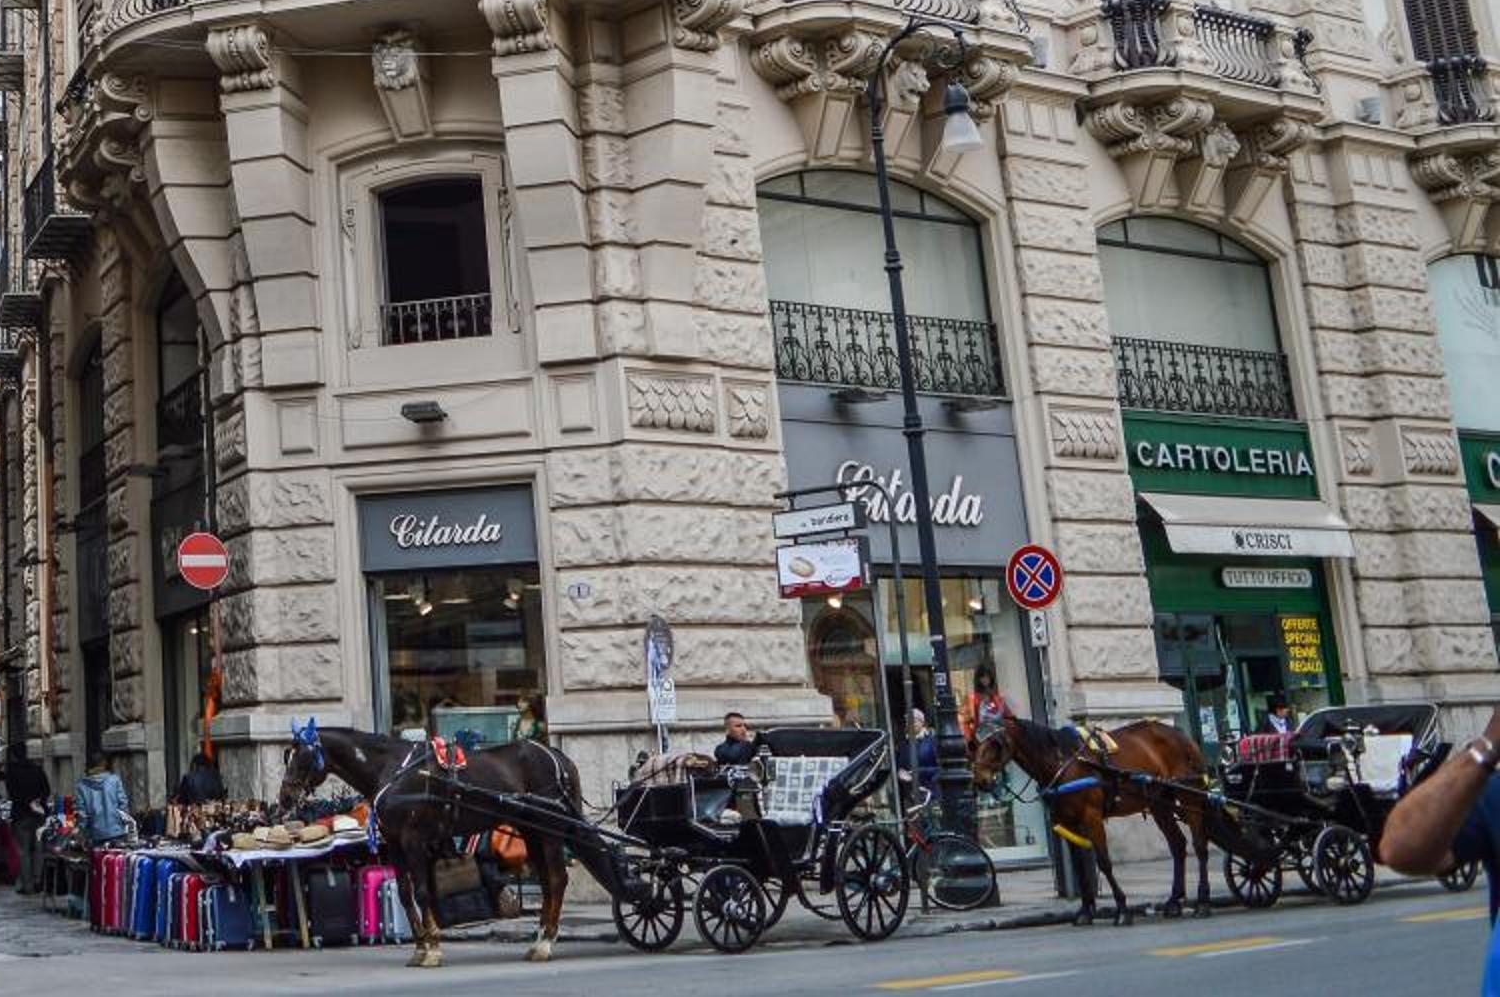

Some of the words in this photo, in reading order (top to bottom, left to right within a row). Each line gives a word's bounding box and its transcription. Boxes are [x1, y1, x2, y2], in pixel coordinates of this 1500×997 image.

[1137, 441, 1316, 476] CARTOLERIA
[836, 460, 983, 525] Citada
[389, 514, 502, 548] Citarda
